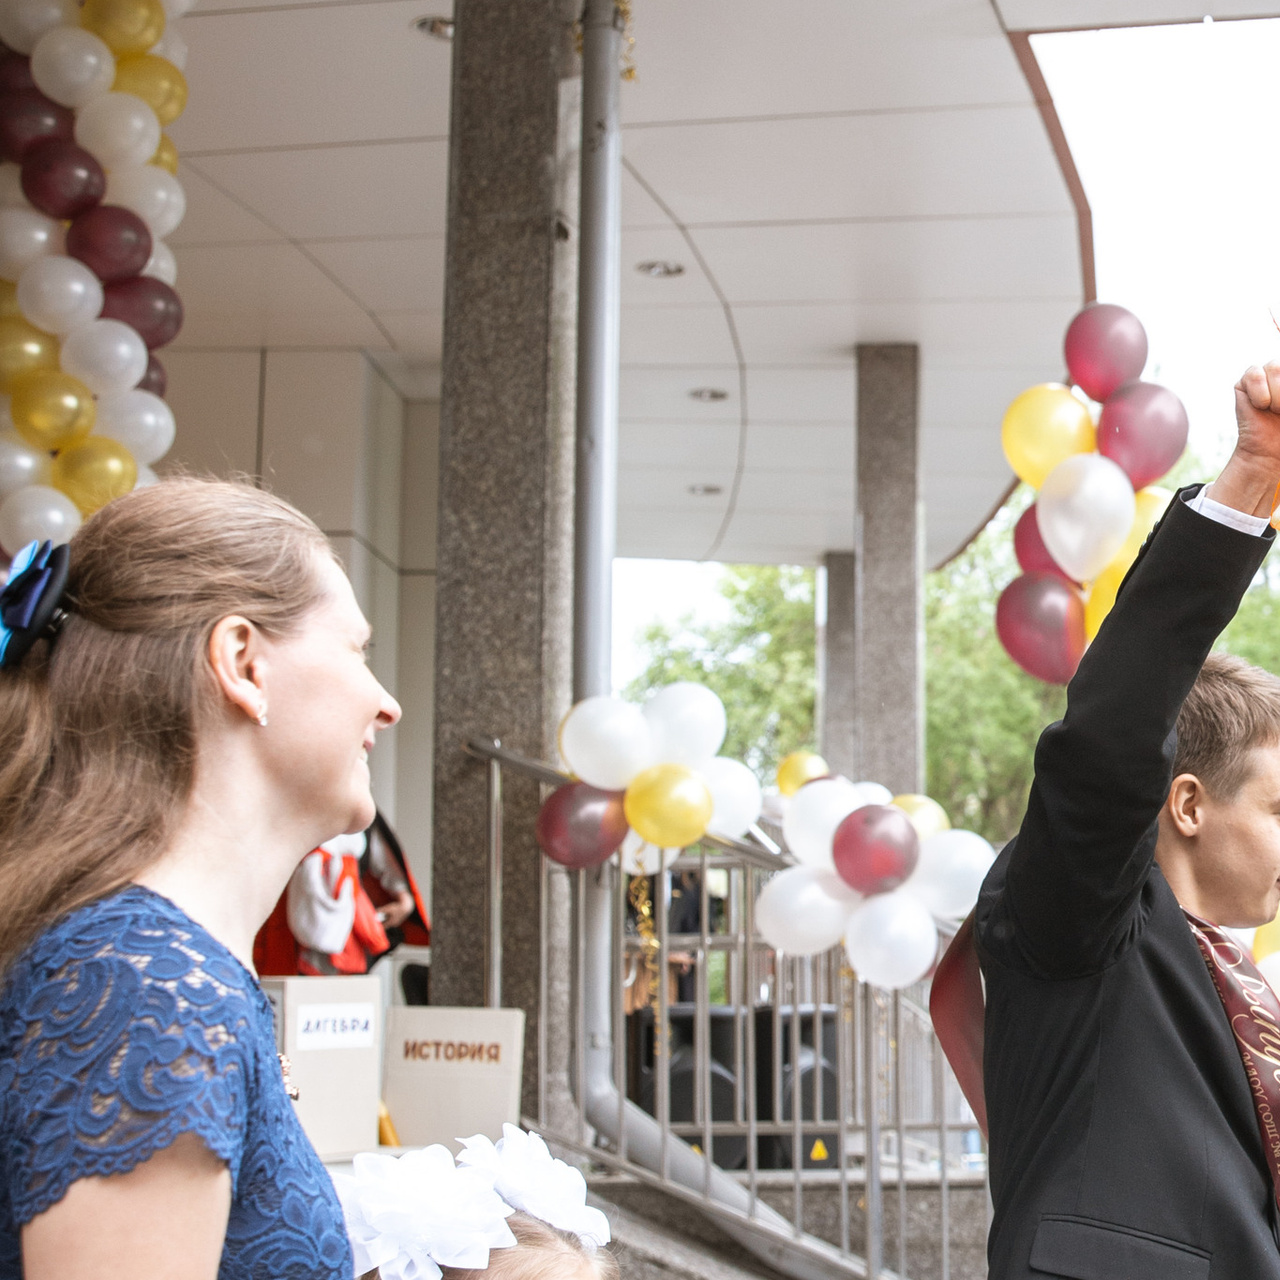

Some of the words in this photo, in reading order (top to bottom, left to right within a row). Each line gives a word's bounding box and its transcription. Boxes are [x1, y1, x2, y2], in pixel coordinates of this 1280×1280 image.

[302, 1017, 370, 1033] АЛГЕБРА
[403, 1039, 501, 1063] ИСТОРИЯ
[1257, 1103, 1280, 1141] СОШ
